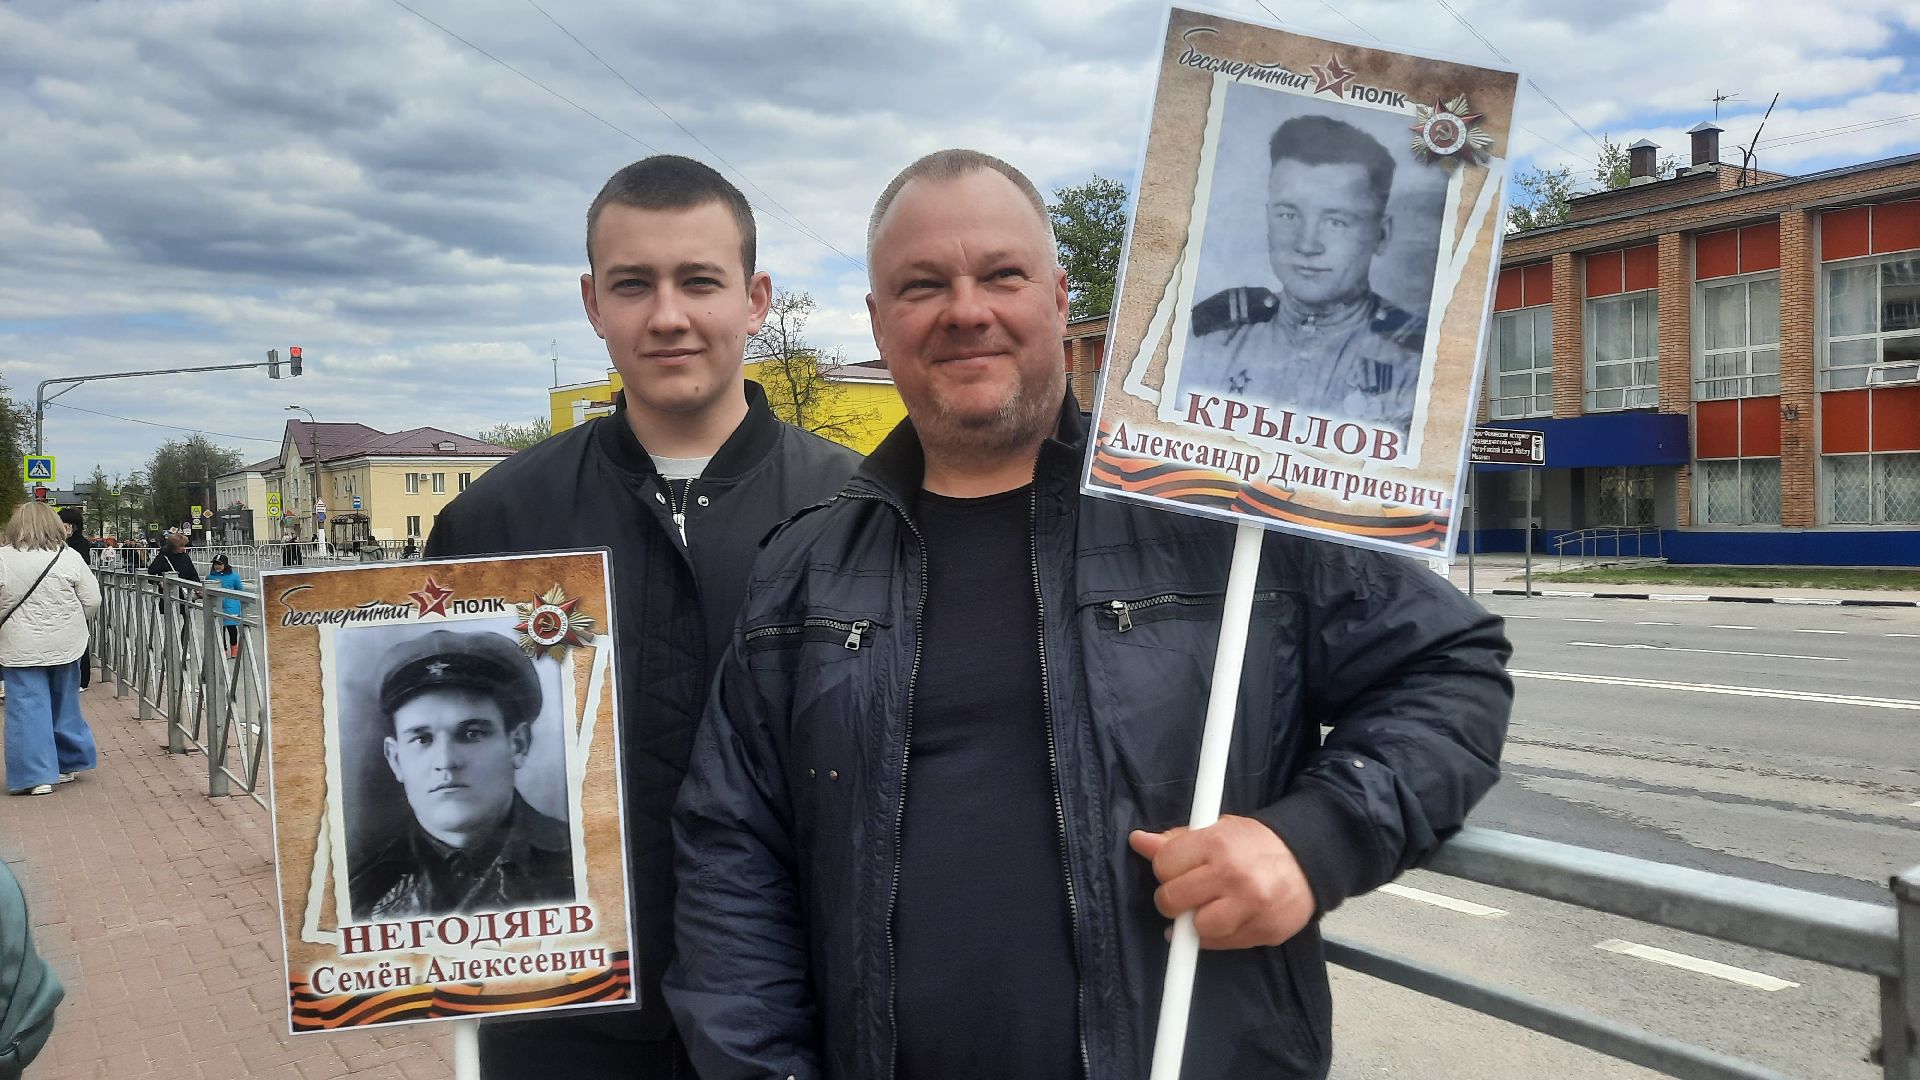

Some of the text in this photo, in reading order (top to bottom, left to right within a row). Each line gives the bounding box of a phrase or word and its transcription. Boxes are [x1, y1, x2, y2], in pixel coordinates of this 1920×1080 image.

[1179, 28, 1312, 90] бессмертный
[1184, 392, 1399, 461] КРЫЛОВ
[1502, 446, 1514, 454] Local
[1108, 422, 1444, 510] Александр Дмитриевич
[280, 585, 413, 628] бессмертный
[340, 905, 594, 955] НЕГОДЯЕВ
[311, 948, 607, 995] Семён Алексеевич
